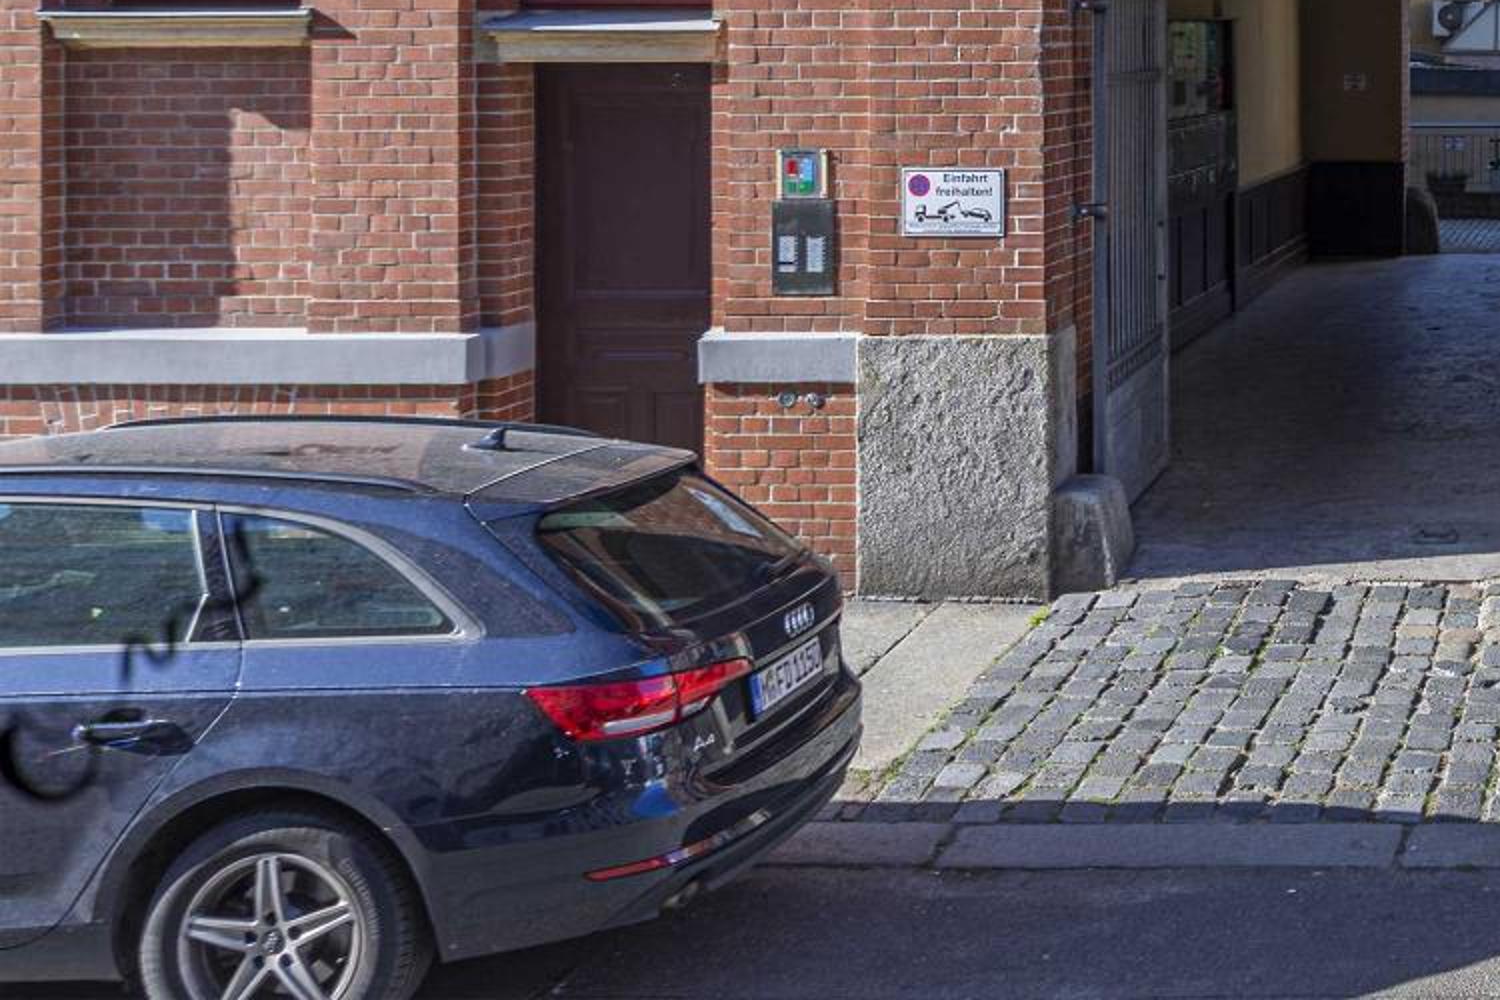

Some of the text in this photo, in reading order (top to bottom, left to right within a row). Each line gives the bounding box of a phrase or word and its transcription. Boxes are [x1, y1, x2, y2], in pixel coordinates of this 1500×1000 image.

[943, 173, 988, 183] Einfahrt
[935, 186, 993, 196] freihalten!
[693, 733, 715, 752] A4
